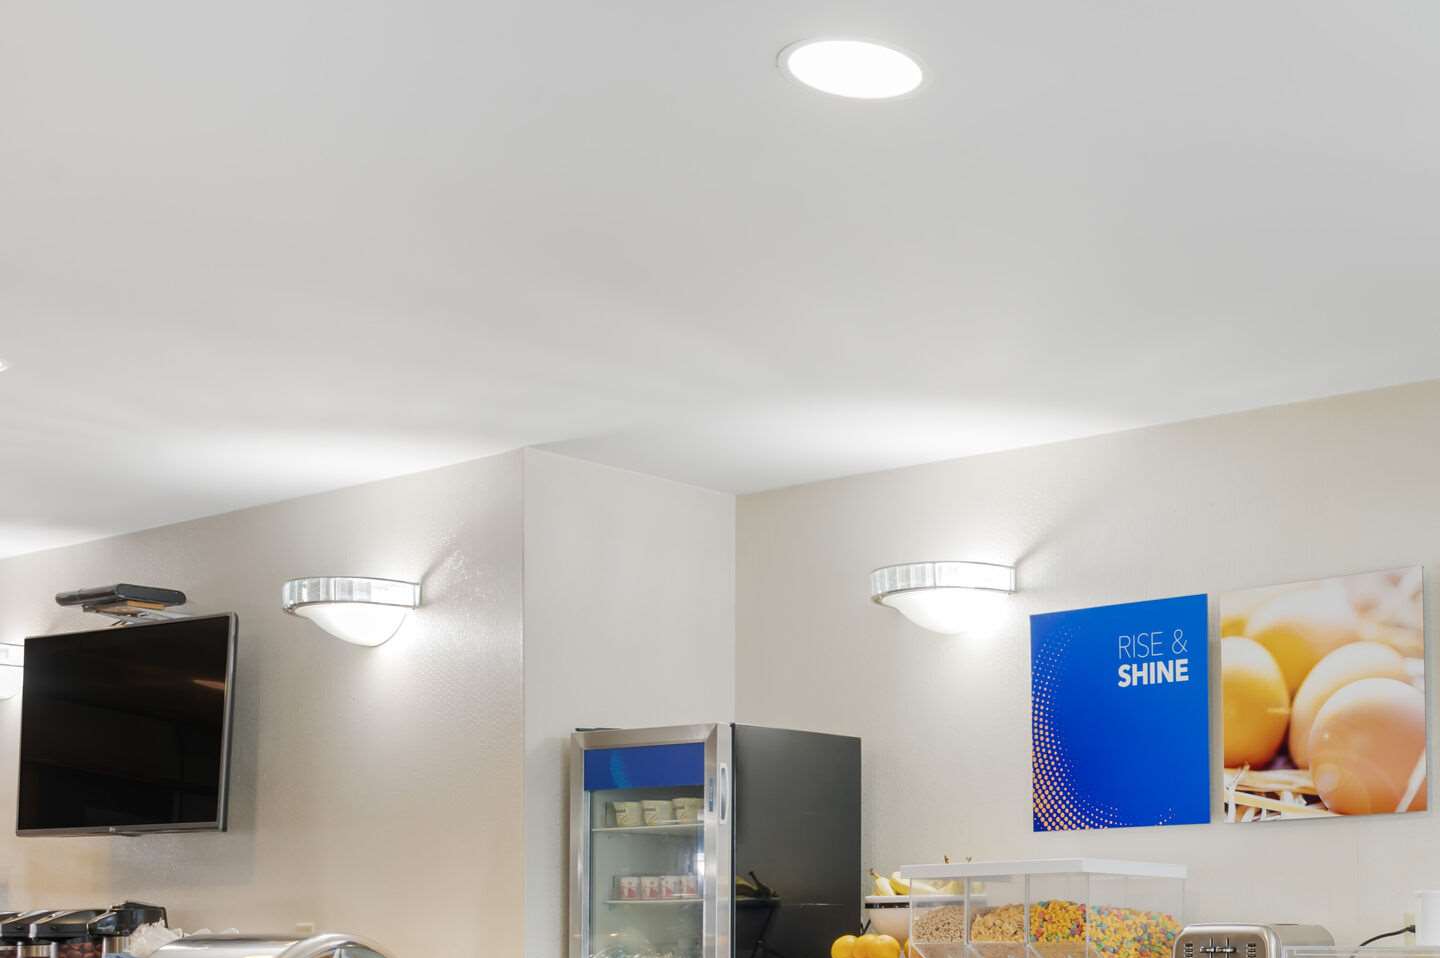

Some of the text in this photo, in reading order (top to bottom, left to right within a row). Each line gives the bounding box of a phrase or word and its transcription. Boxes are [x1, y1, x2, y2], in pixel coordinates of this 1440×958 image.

[1118, 628, 1188, 660] RISE &
[1118, 658, 1189, 688] SHINE
